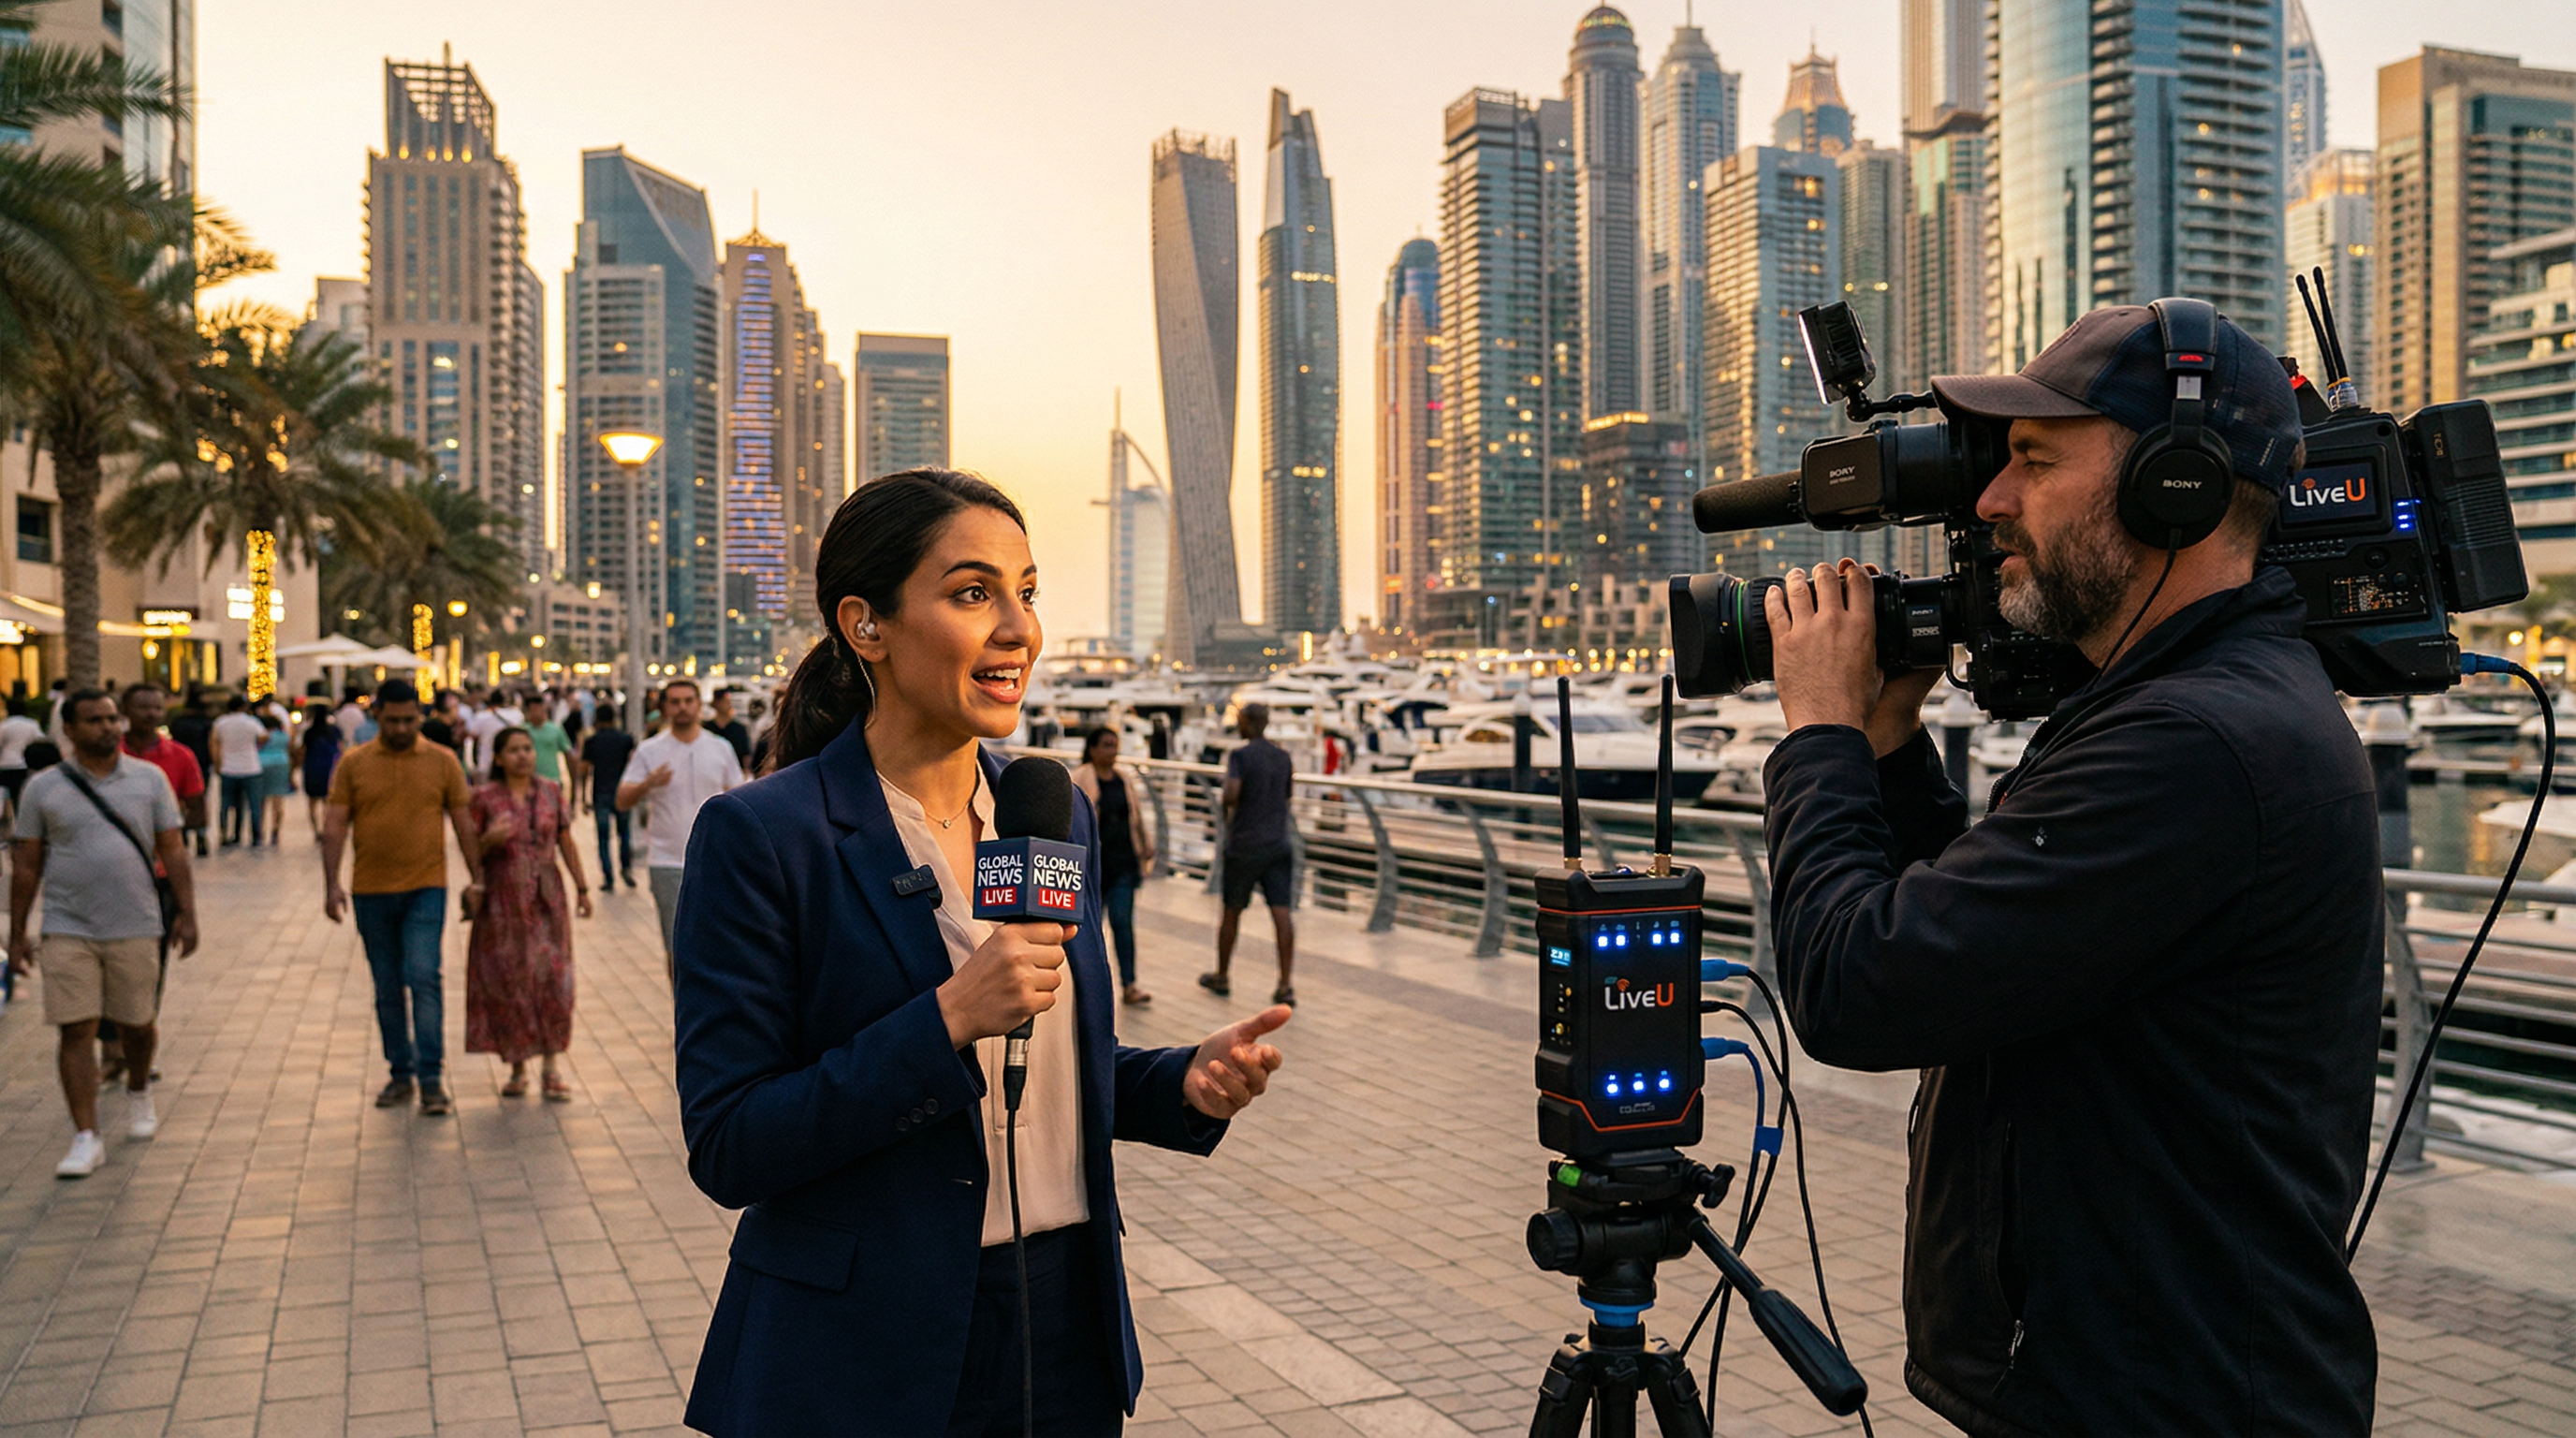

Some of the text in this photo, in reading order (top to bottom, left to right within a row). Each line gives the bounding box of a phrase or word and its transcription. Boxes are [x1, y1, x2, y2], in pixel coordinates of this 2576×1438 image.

[2289, 477, 2366, 506] LiveU
[977, 854, 1024, 871] GLOBAL
[1033, 854, 1083, 874] GLOBAL
[977, 868, 1023, 887] NEWS
[1032, 868, 1082, 891] NEWS
[985, 888, 1013, 904] LIVE
[1041, 889, 1072, 907] LIVE
[1604, 978, 1674, 1010] LiveU
